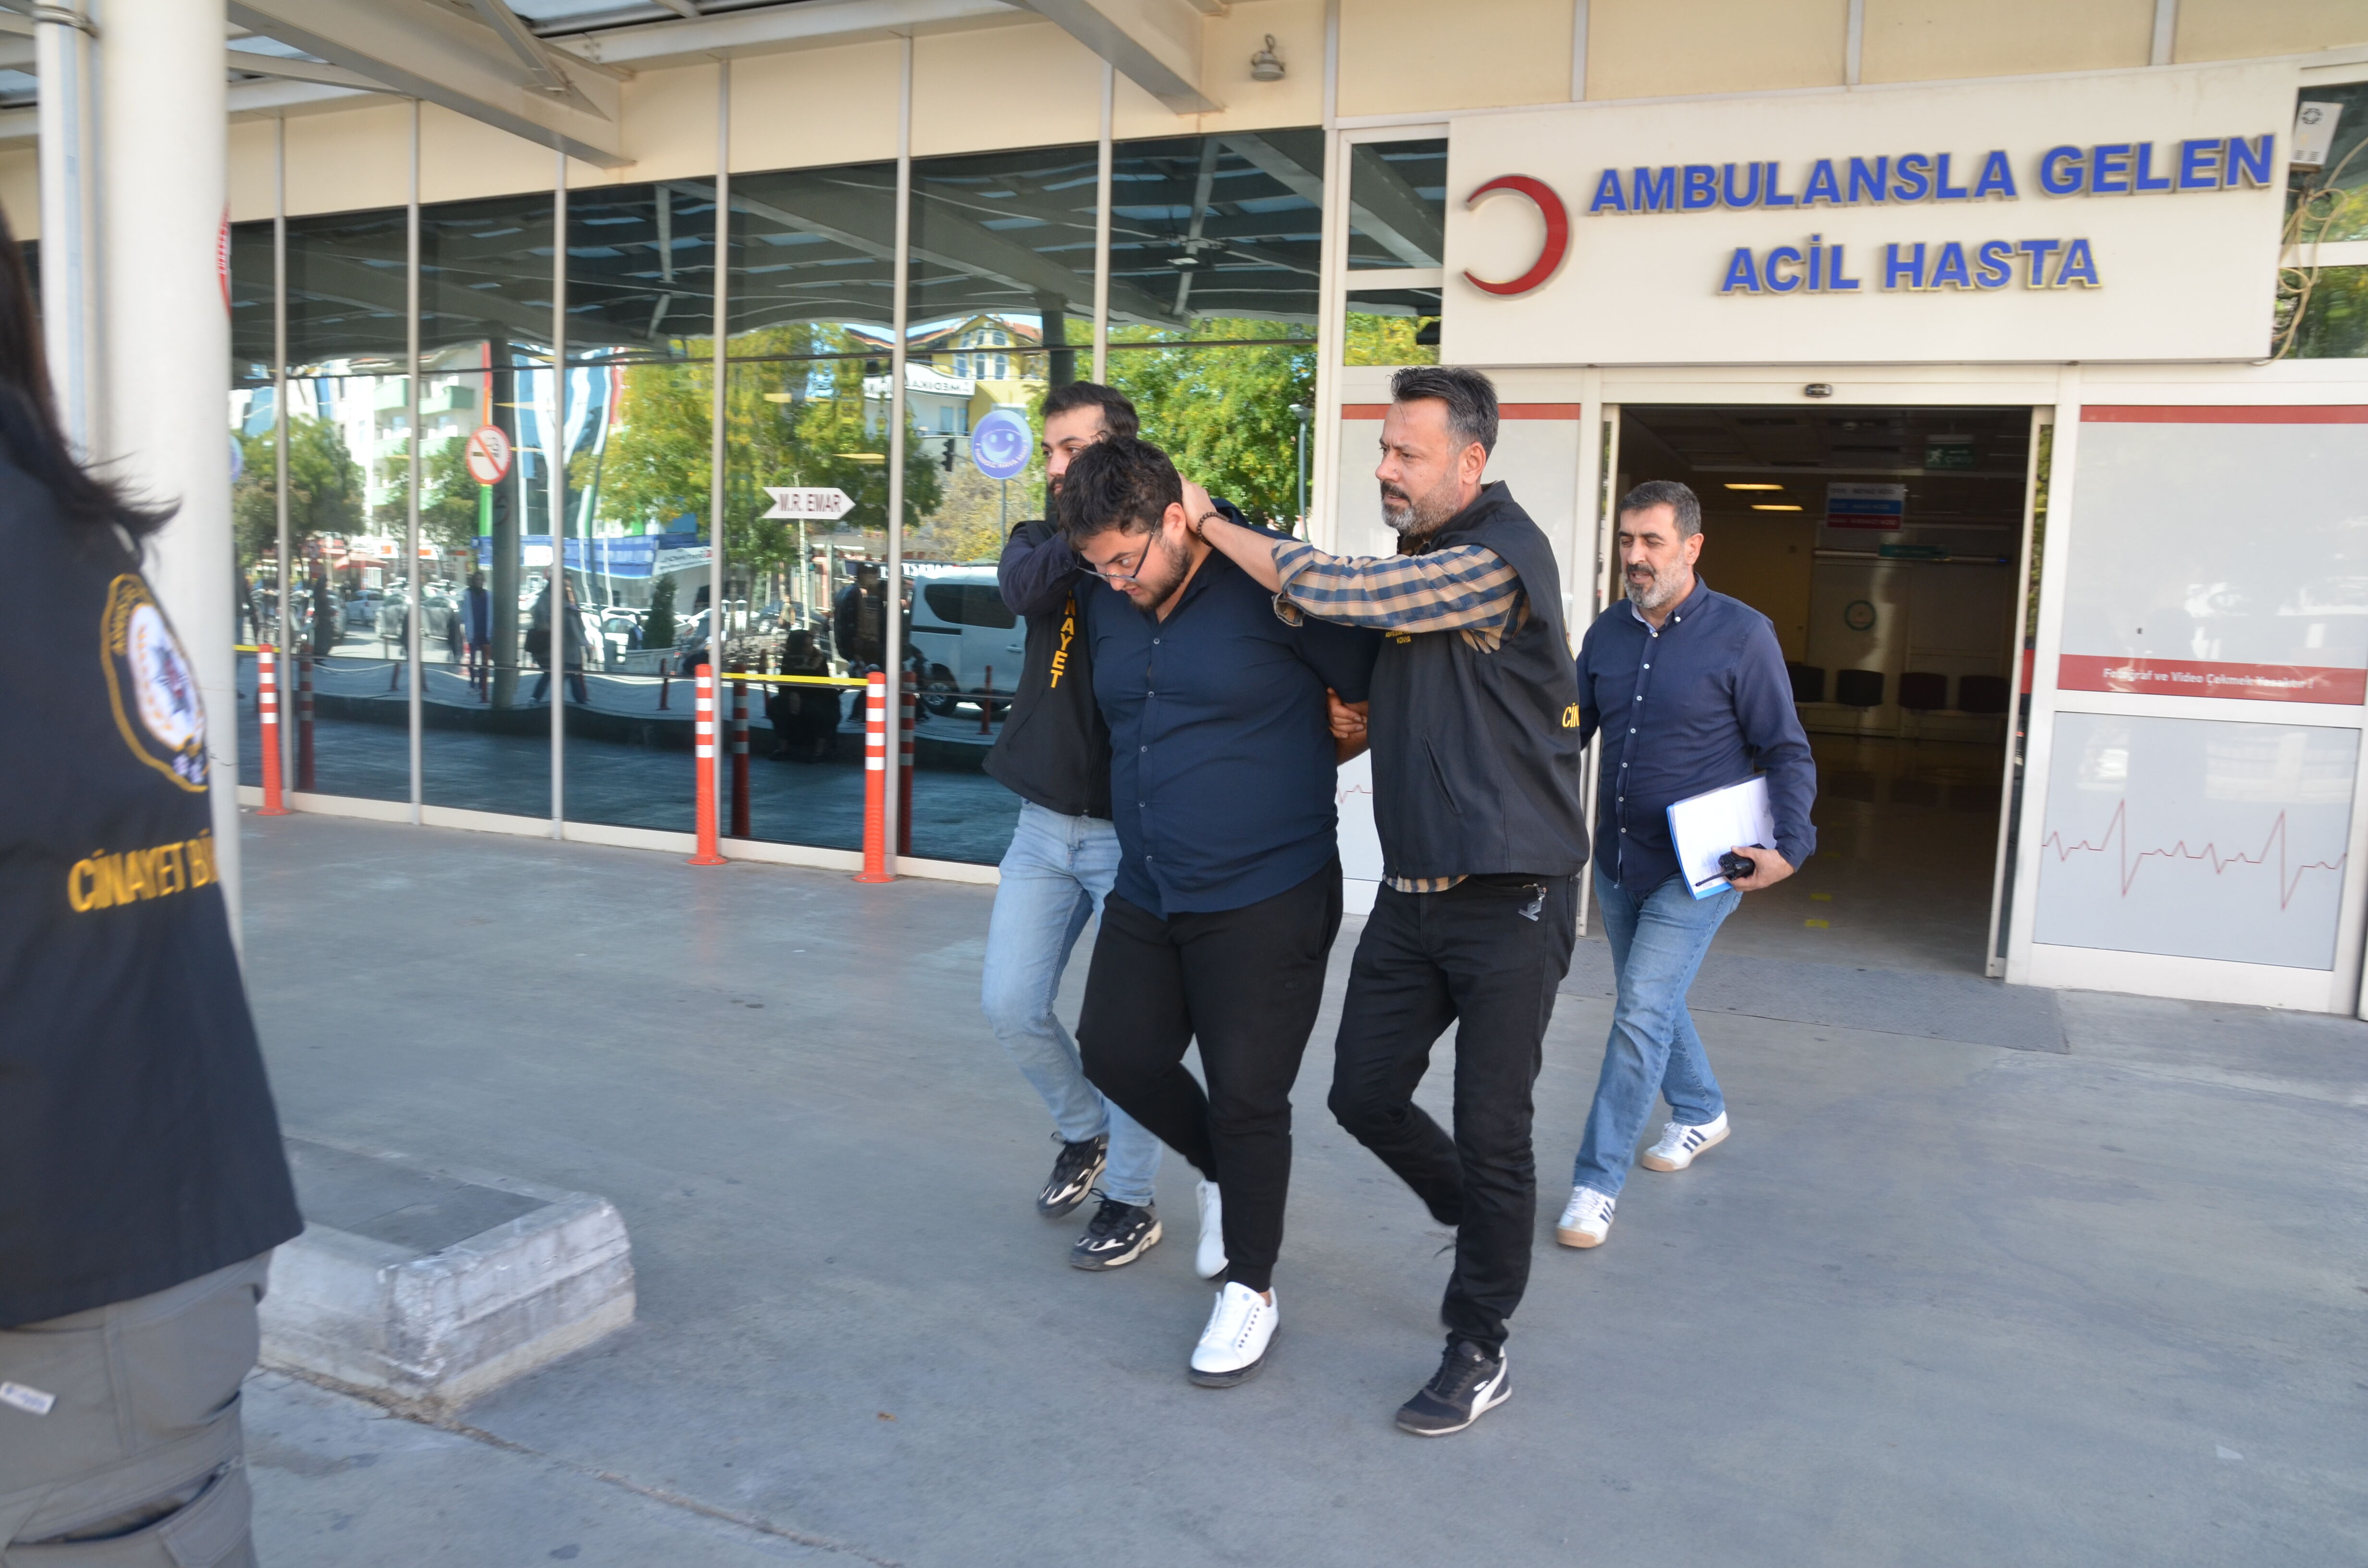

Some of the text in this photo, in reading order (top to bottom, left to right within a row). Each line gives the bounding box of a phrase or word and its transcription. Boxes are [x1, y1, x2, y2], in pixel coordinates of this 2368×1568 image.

[1587, 133, 2275, 215] AMBULANSLA GELEN
[1718, 233, 2102, 295] ACİL HASTA
[779, 493, 842, 513] M.R. EMAR
[2171, 672, 2204, 683] Video
[67, 842, 185, 912] CİNAYET
